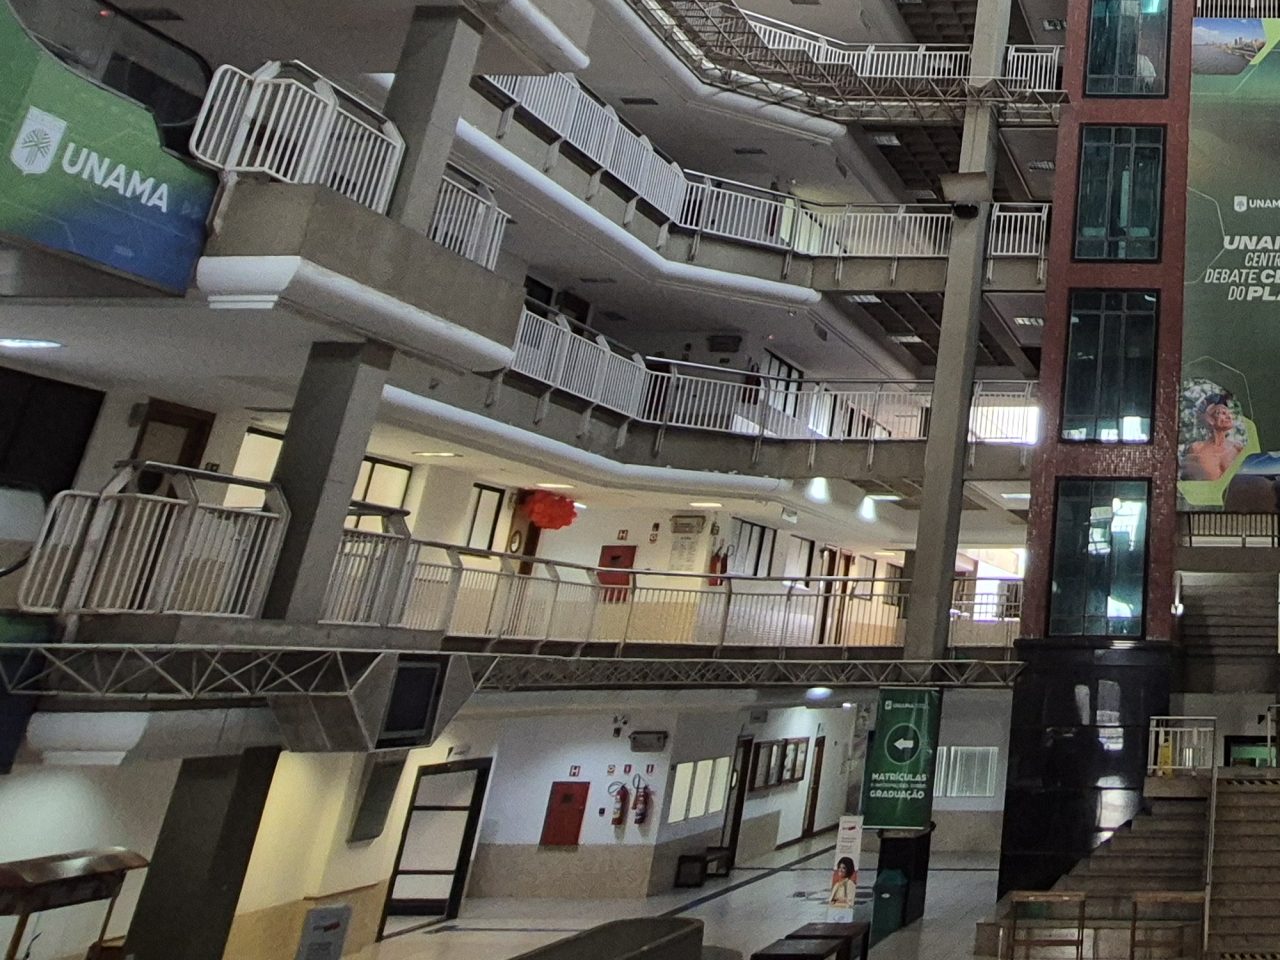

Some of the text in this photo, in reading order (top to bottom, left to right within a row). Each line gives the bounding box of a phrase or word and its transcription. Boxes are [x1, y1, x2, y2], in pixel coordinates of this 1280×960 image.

[62, 142, 169, 213] UNAMA
[1204, 269, 1257, 284] DEBATE
[1227, 286, 1246, 301] DO
[871, 772, 927, 782] MATRÍCULAS
[869, 789, 925, 800] GRADUAÇÃO
